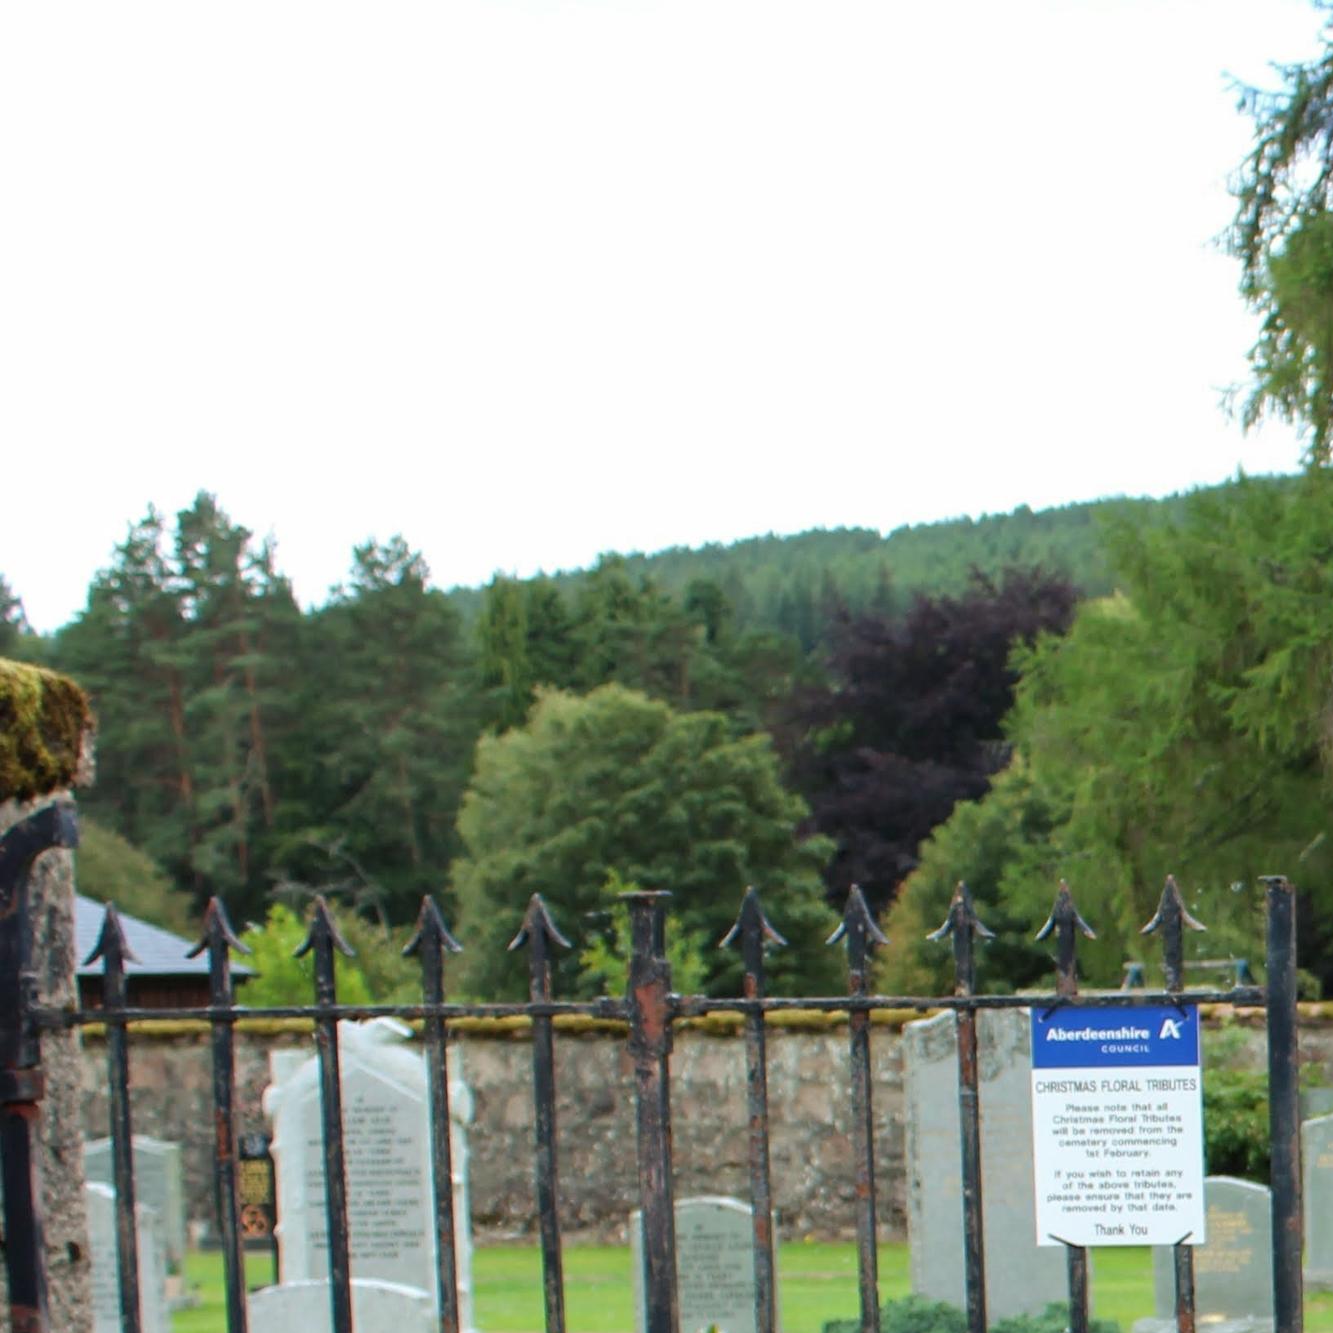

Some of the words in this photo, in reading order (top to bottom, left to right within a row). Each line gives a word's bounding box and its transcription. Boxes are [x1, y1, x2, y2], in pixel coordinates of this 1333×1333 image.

[1046, 1027, 1150, 1041] Aberdeenshire
[1101, 1044, 1150, 1054] COUNCIL
[1035, 1080, 1097, 1094] CHRISTMAS
[1101, 1079, 1141, 1092] FLORAL
[1147, 1078, 1197, 1092] TRIBUTES
[1065, 1103, 1100, 1113] Please
[1104, 1103, 1127, 1112] note
[1132, 1102, 1152, 1111] that
[1157, 1102, 1168, 1111] all
[1053, 1115, 1104, 1124] Christmas
[1109, 1114, 1137, 1123] Floral
[1142, 1113, 1182, 1122] Tributes
[1052, 1127, 1068, 1136] will
[1072, 1127, 1086, 1136] be
[1090, 1125, 1134, 1135] removed
[1139, 1125, 1162, 1134] from
[1167, 1124, 1183, 1134] the
[1059, 1138, 1107, 1148] cemetery
[1112, 1136, 1178, 1147] commencing
[1066, 1171, 1084, 1179] you
[1089, 1169, 1112, 1178] wish
[1116, 1169, 1127, 1178] to
[1131, 1168, 1161, 1178] retain
[1165, 1169, 1183, 1178] any
[1062, 1181, 1073, 1190] of
[1077, 1181, 1094, 1190] the
[1098, 1181, 1130, 1190] above
[1047, 1193, 1081, 1203] please
[1085, 1193, 1120, 1201] ensure
[1125, 1191, 1145, 1201] that
[1149, 1191, 1172, 1201] they
[1176, 1192, 1193, 1200] are
[1062, 1203, 1106, 1213] removed
[1110, 1204, 1123, 1214] by
[1127, 1203, 1148, 1212] that
[1095, 1224, 1124, 1235] Thank
[1129, 1223, 1148, 1235] You
